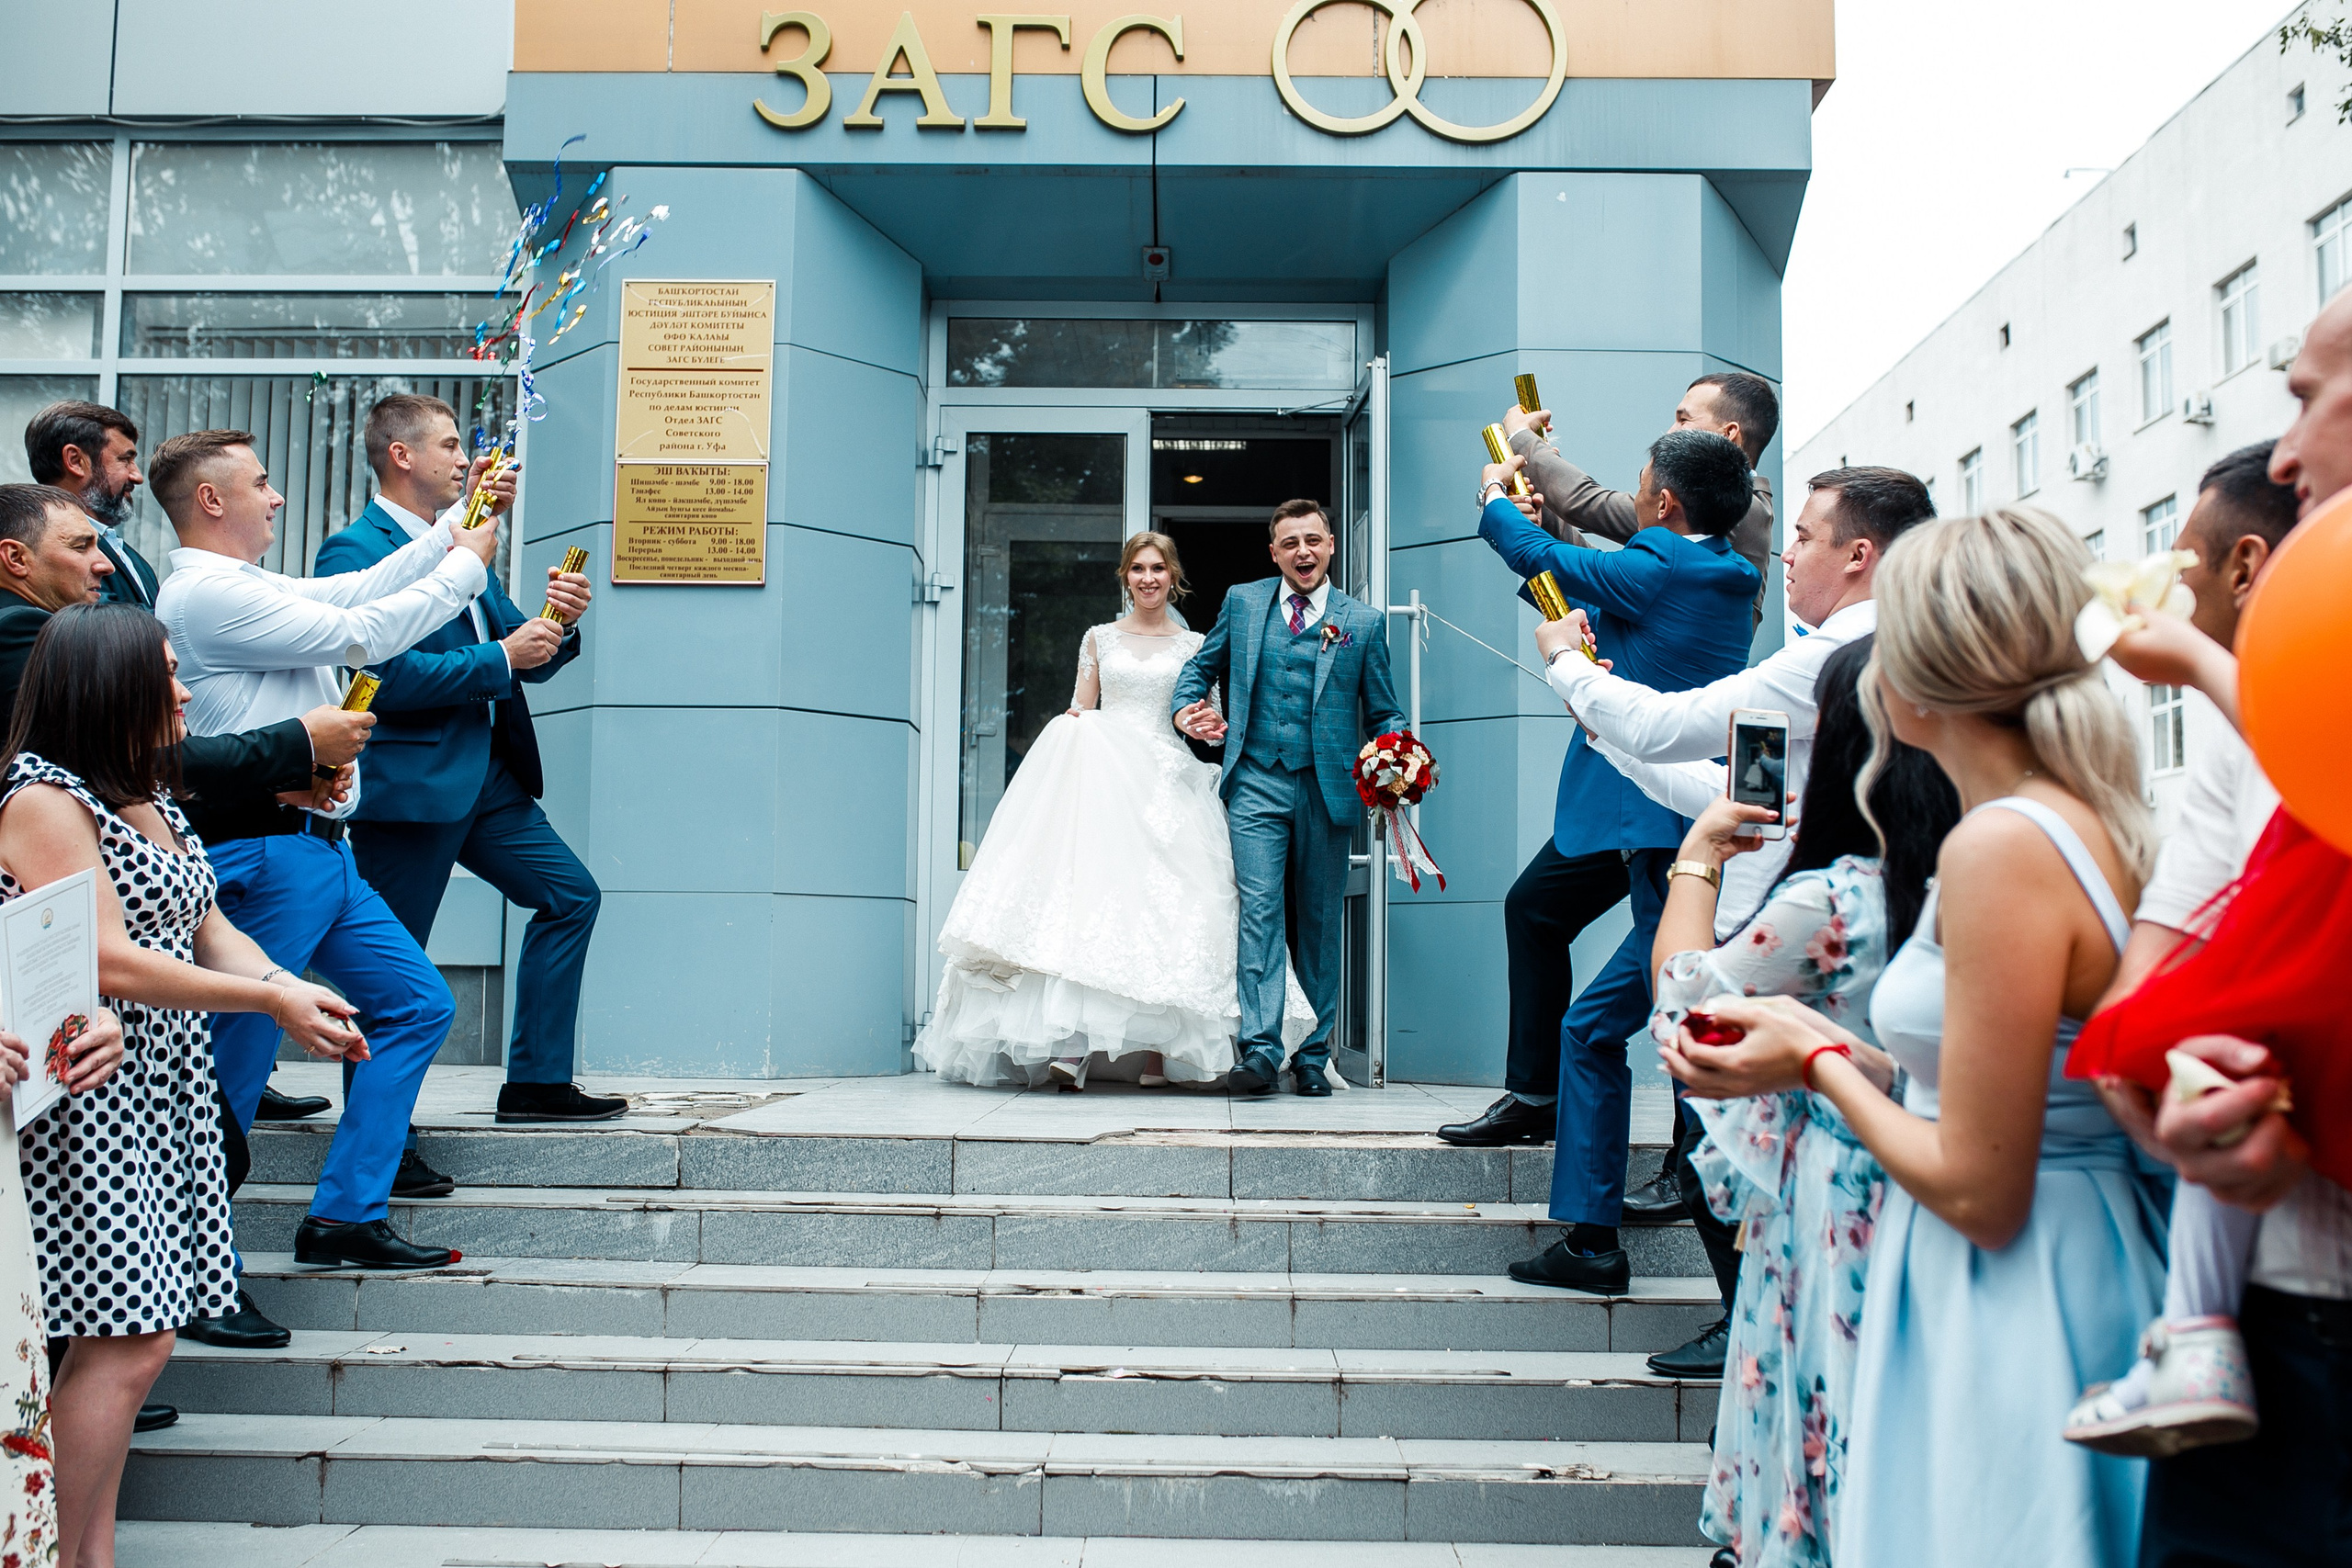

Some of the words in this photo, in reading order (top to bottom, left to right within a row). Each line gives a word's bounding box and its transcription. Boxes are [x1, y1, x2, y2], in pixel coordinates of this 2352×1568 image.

[752, 11, 1187, 133] ЗАГС
[628, 310, 677, 319] ЮСТИЦИЯ
[720, 310, 766, 318] БУЙЫНСА
[630, 377, 716, 387] Государственный
[629, 389, 686, 400] Республики
[689, 390, 761, 400] Башкортостан
[664, 416, 695, 424] Отдел
[666, 429, 720, 437] Советского
[660, 443, 695, 452] района
[707, 443, 726, 452] Уфа
[642, 526, 685, 535] РЕЖИМ
[689, 526, 739, 536] РАБОТЫ:
